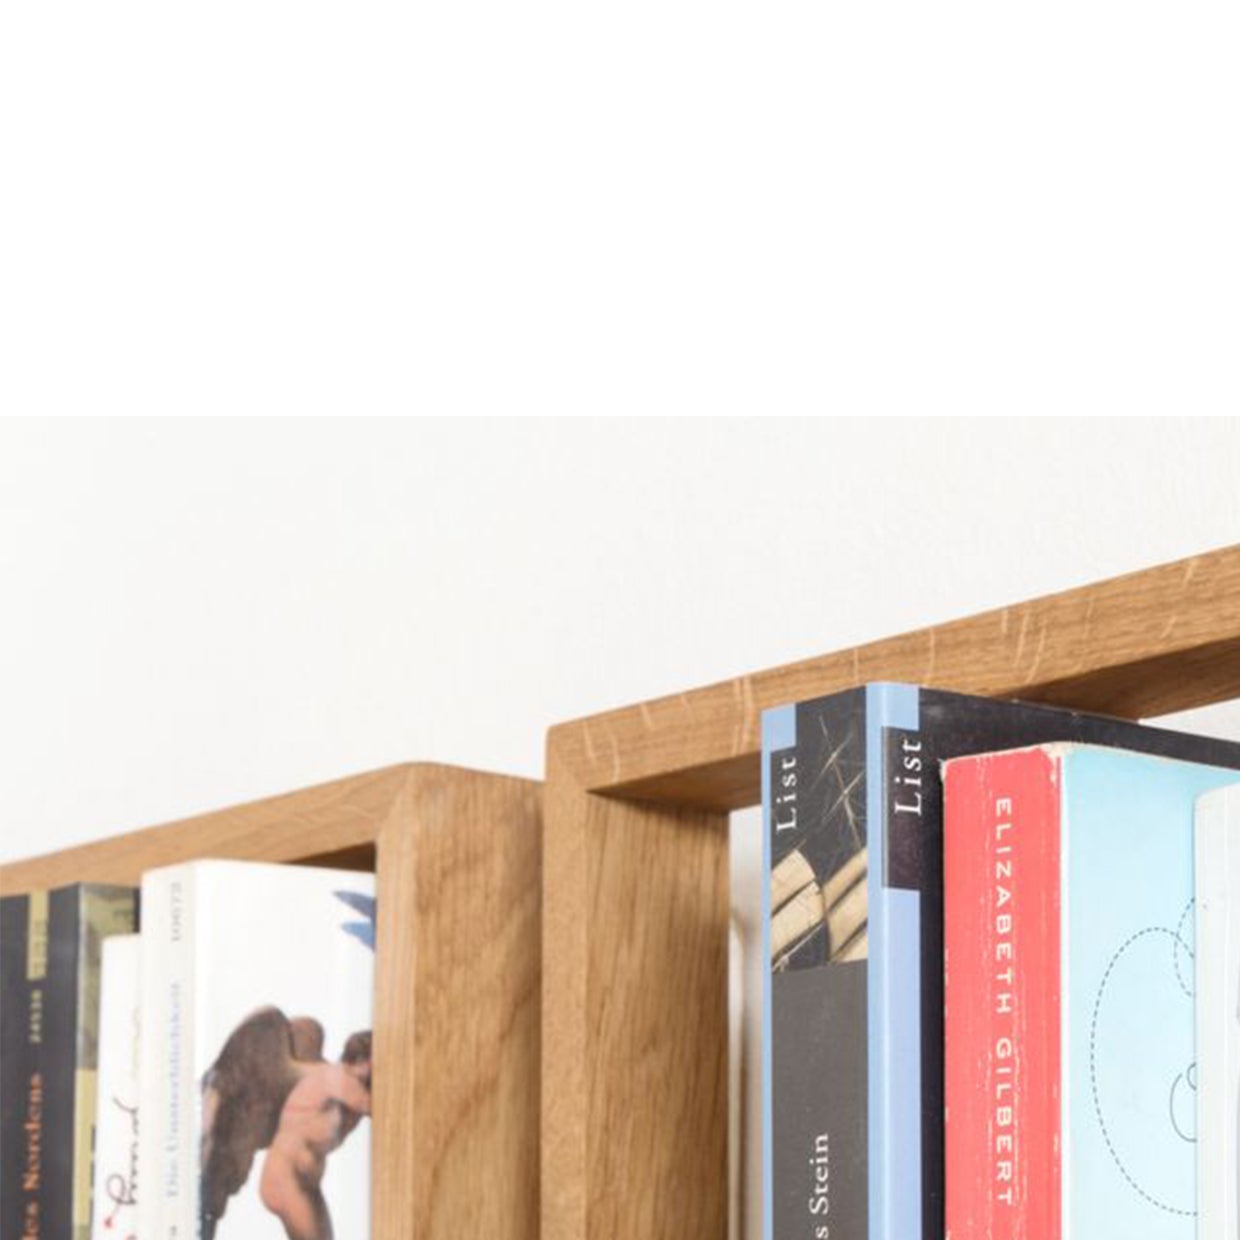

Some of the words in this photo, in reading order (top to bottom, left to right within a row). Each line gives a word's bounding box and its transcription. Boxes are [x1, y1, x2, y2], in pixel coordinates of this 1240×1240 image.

[776, 756, 798, 832] List
[895, 739, 923, 817] List
[996, 797, 1013, 1014] ELIZABETH
[24, 1073, 43, 1193] Nordens
[996, 1037, 1014, 1206] GILBERT
[809, 1133, 830, 1216] Stein
